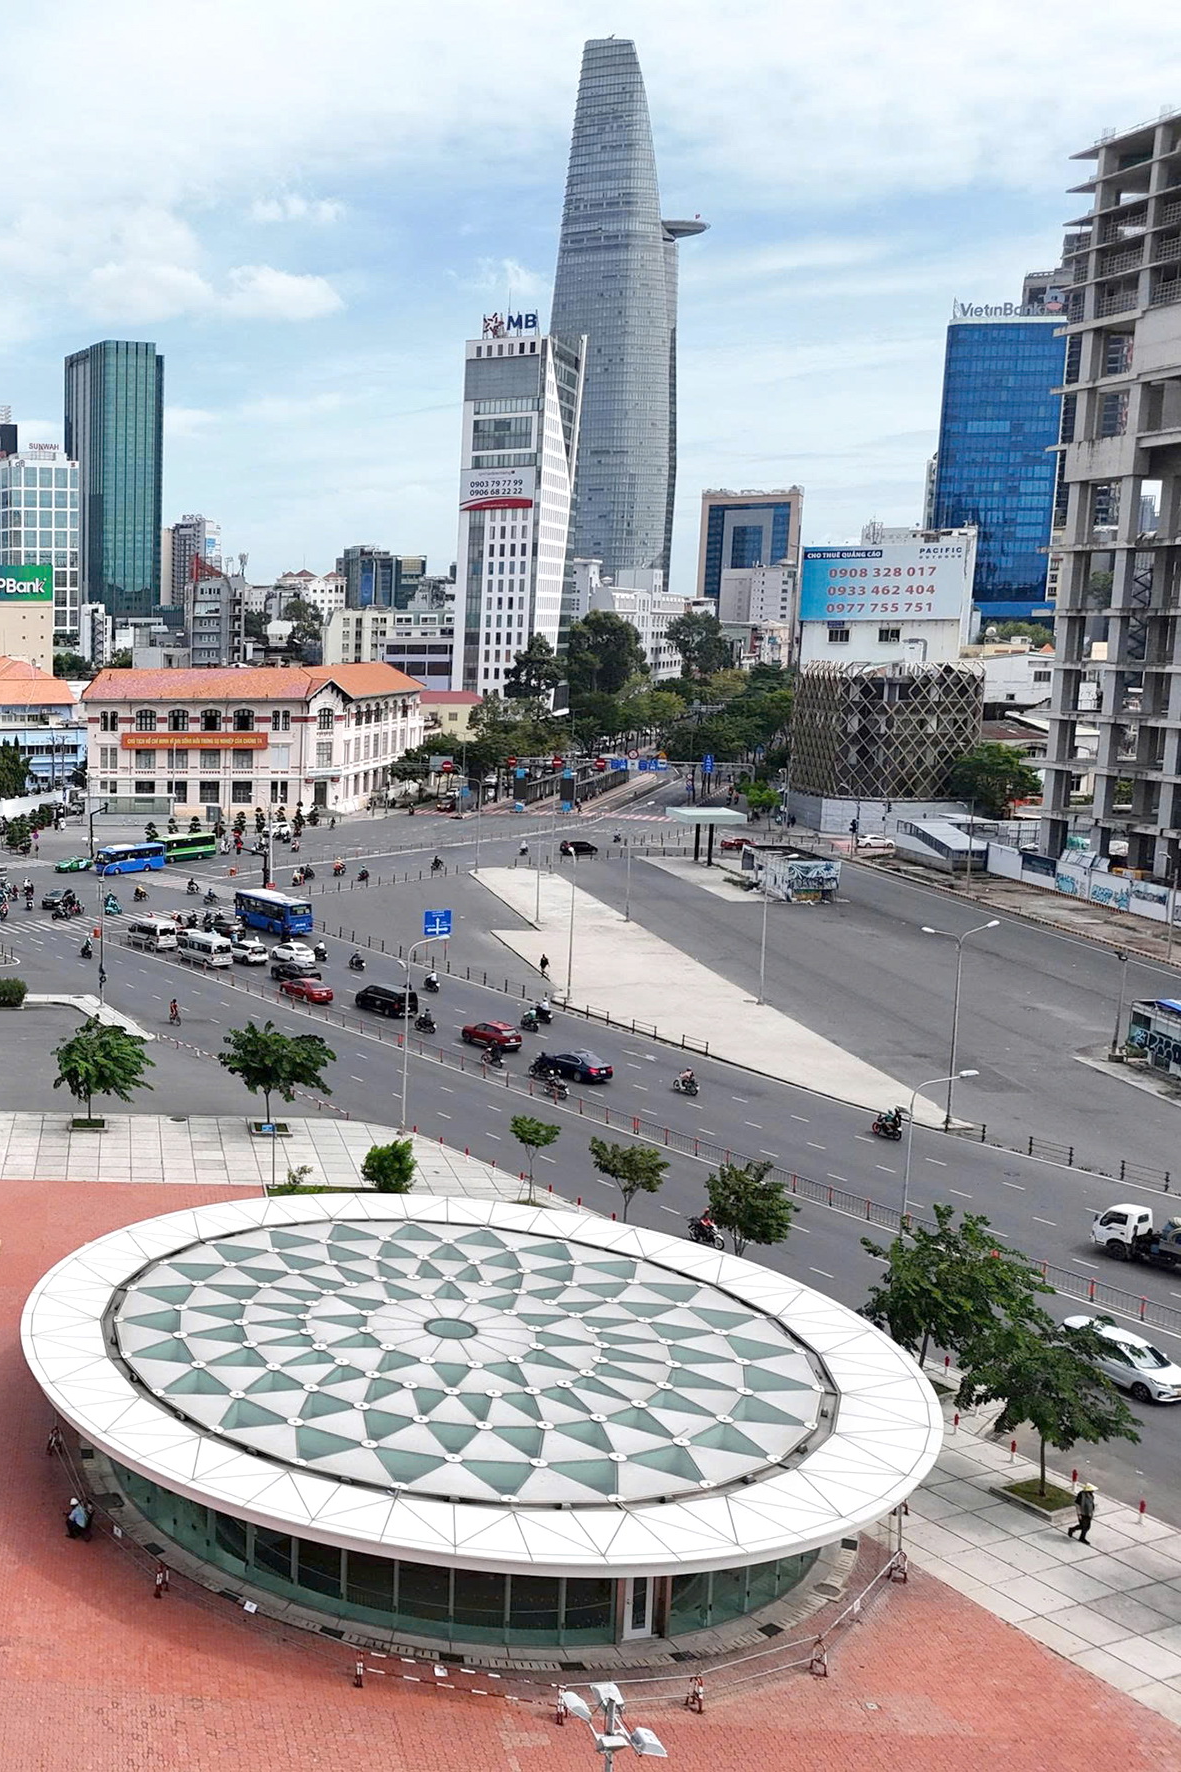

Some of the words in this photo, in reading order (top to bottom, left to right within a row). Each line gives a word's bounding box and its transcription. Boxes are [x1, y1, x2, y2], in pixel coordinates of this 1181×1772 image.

[960, 302, 1043, 317] VietinBank
[507, 314, 537, 330] MB
[29, 443, 59, 451] SUNWAH
[829, 568, 868, 578] 0908
[872, 567, 902, 577] 328
[907, 566, 937, 577] 017
[827, 586, 866, 596] 0933
[871, 585, 900, 595] 462
[905, 584, 935, 595] 404
[826, 603, 865, 613] 0977
[870, 602, 899, 613] 755
[904, 602, 932, 612] 751
